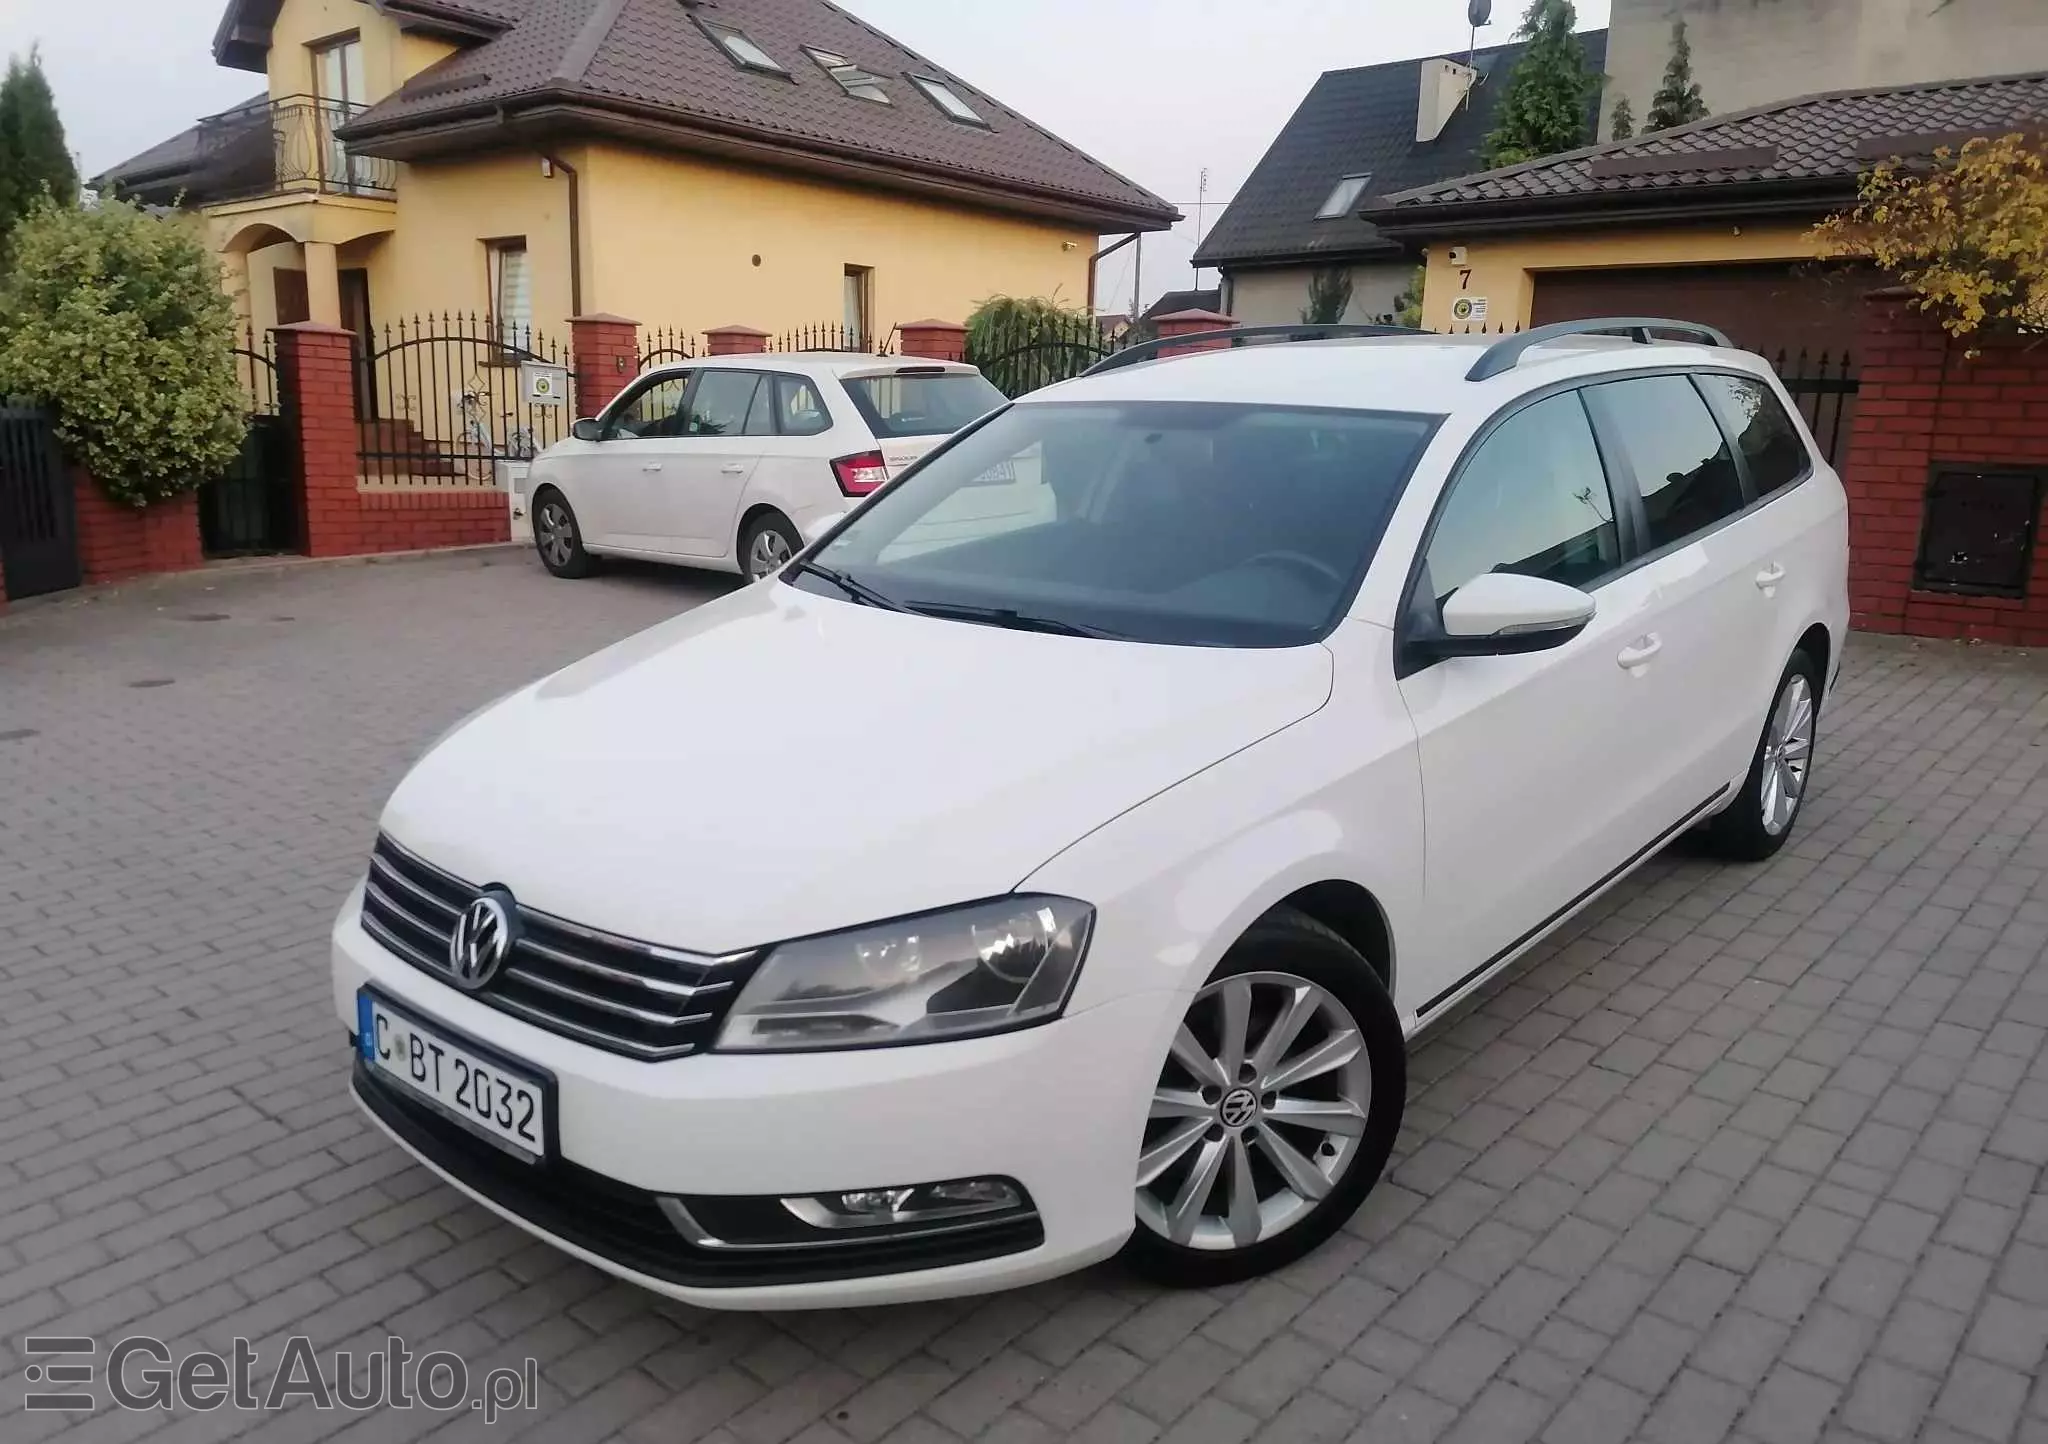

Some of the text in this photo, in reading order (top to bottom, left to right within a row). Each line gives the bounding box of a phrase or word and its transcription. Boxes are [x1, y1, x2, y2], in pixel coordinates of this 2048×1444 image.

[1459, 269, 1472, 290] 7
[376, 1012, 536, 1143] C BT 2032
